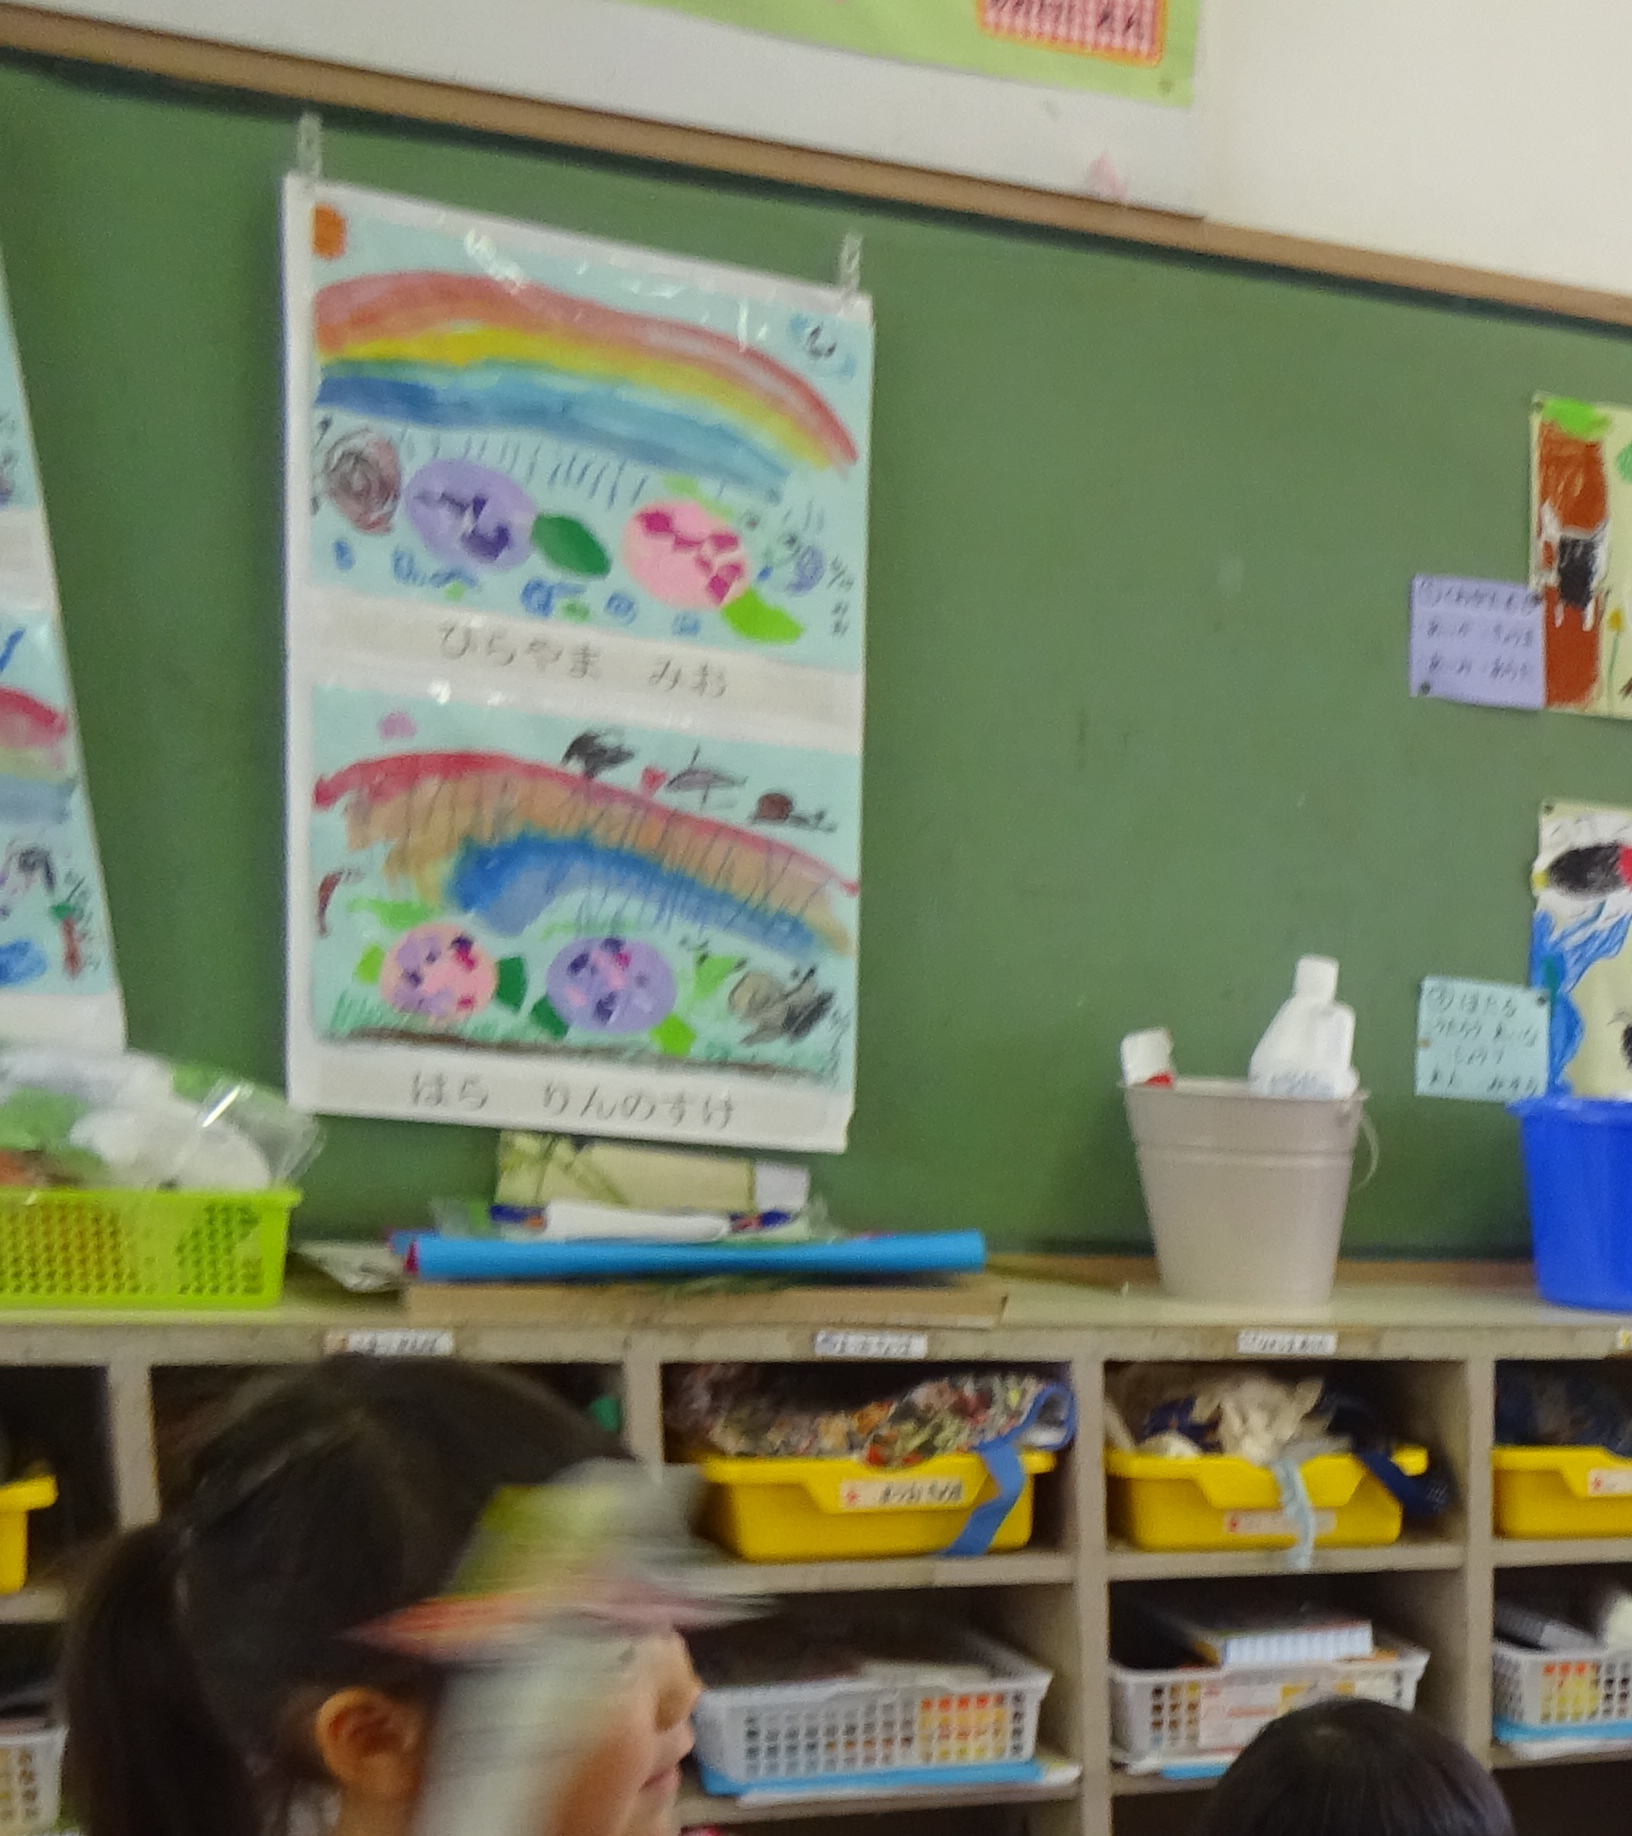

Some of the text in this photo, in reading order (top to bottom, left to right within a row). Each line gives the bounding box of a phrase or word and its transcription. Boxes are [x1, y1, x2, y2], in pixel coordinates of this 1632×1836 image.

[438, 617, 602, 682] ひらやま
[410, 1069, 490, 1110] はら
